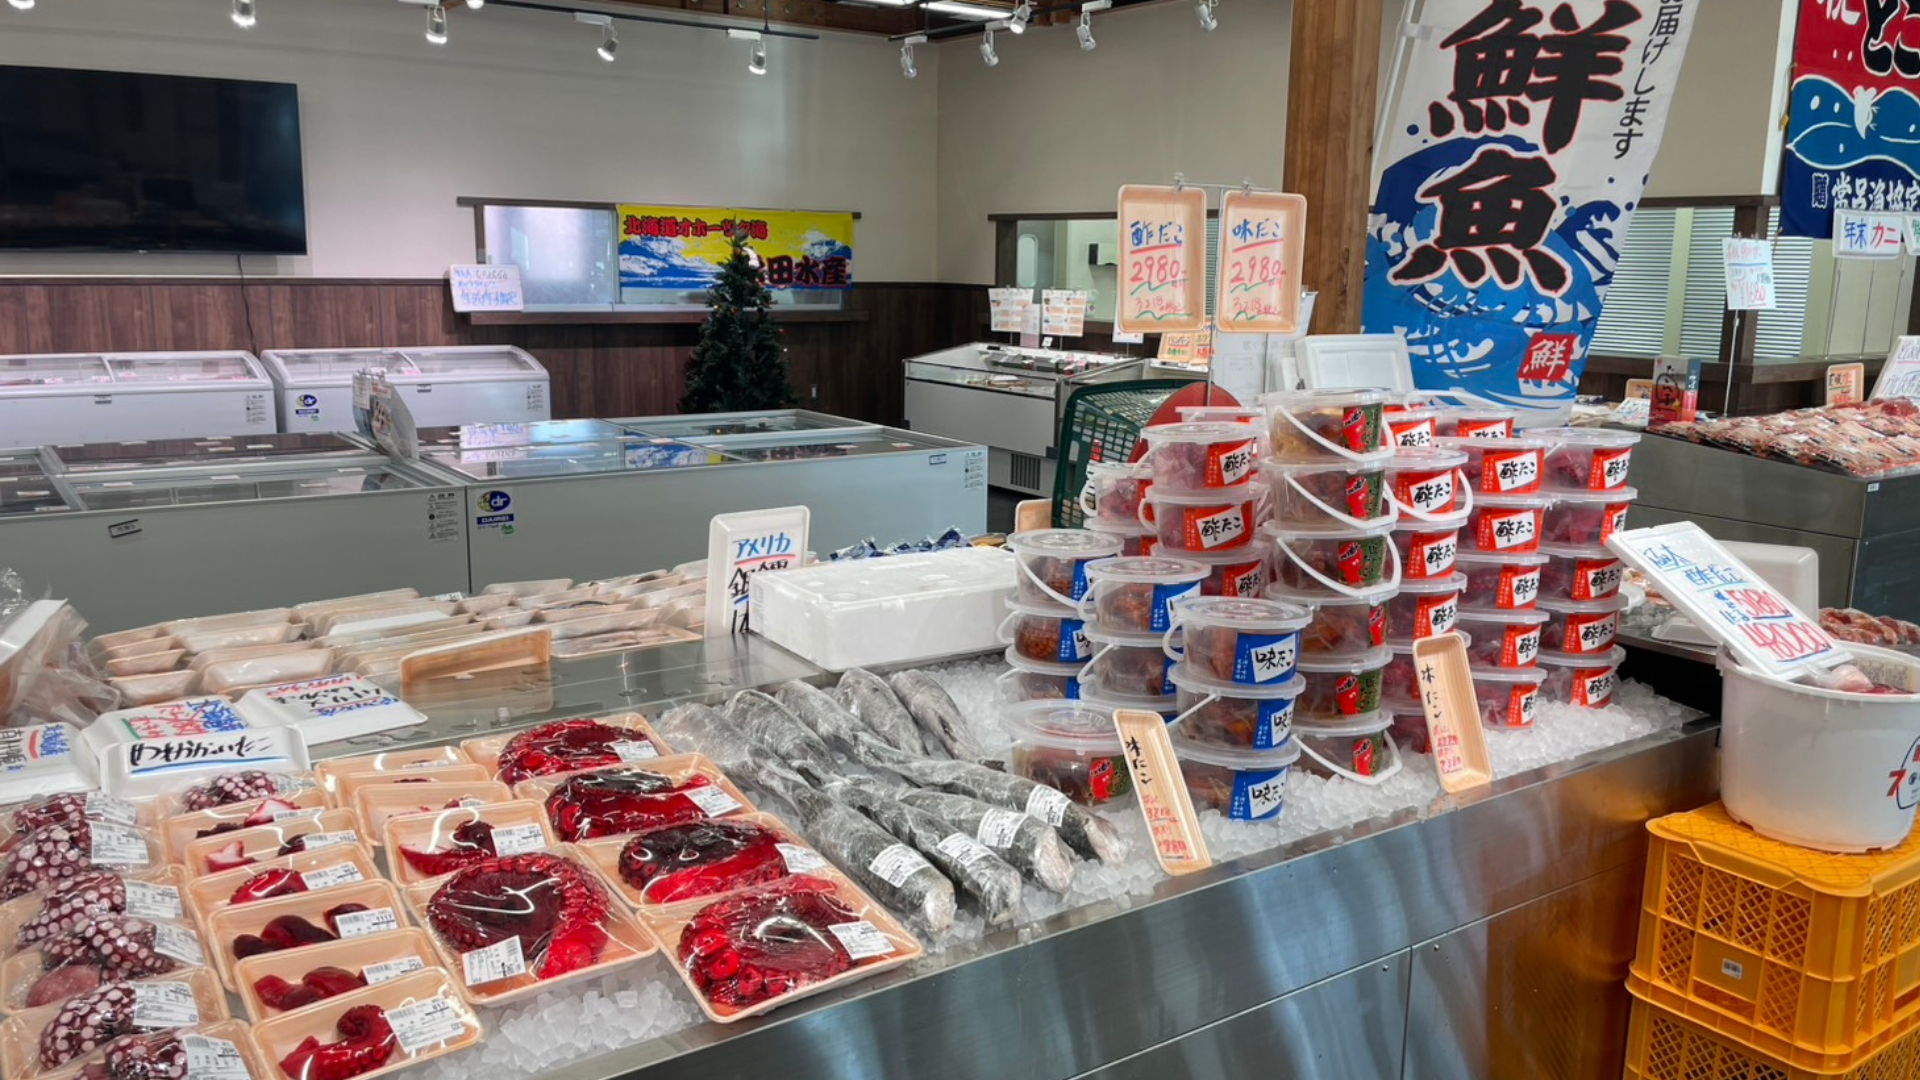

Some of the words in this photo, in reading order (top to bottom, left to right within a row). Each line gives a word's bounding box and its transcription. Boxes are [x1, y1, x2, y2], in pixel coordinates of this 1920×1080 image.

[1613, 0, 1684, 160] 届けします
[1392, 0, 1642, 292] 鮮魚
[1231, 218, 1280, 243] 味だこ
[1529, 340, 1569, 379] 鮮
[1500, 460, 1536, 485] 酢たこ
[490, 496, 507, 507] dr
[1414, 482, 1451, 508] 酢たこ
[1201, 514, 1243, 541] 酢たこ
[1495, 518, 1533, 543] 酢たこ
[733, 532, 791, 559] アメリカ
[1590, 568, 1620, 591] 酢たこ
[1581, 623, 1613, 646] 酢たこ
[1255, 649, 1294, 671] 味たこ
